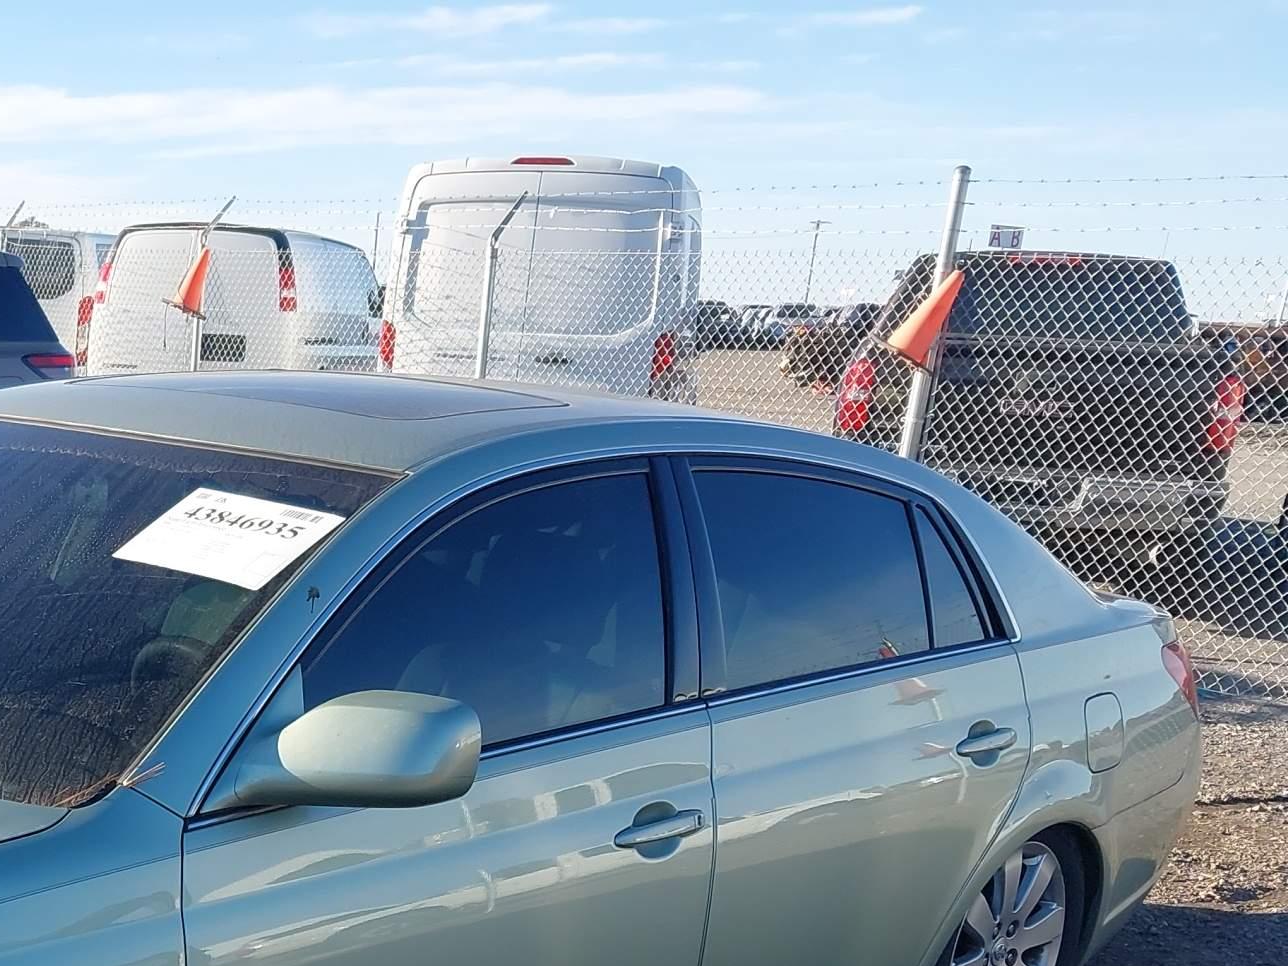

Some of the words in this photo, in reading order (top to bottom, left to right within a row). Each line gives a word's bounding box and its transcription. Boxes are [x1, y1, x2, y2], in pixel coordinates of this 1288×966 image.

[988, 231, 1001, 247] A
[1011, 230, 1021, 248] B
[183, 506, 306, 540] 43846935
